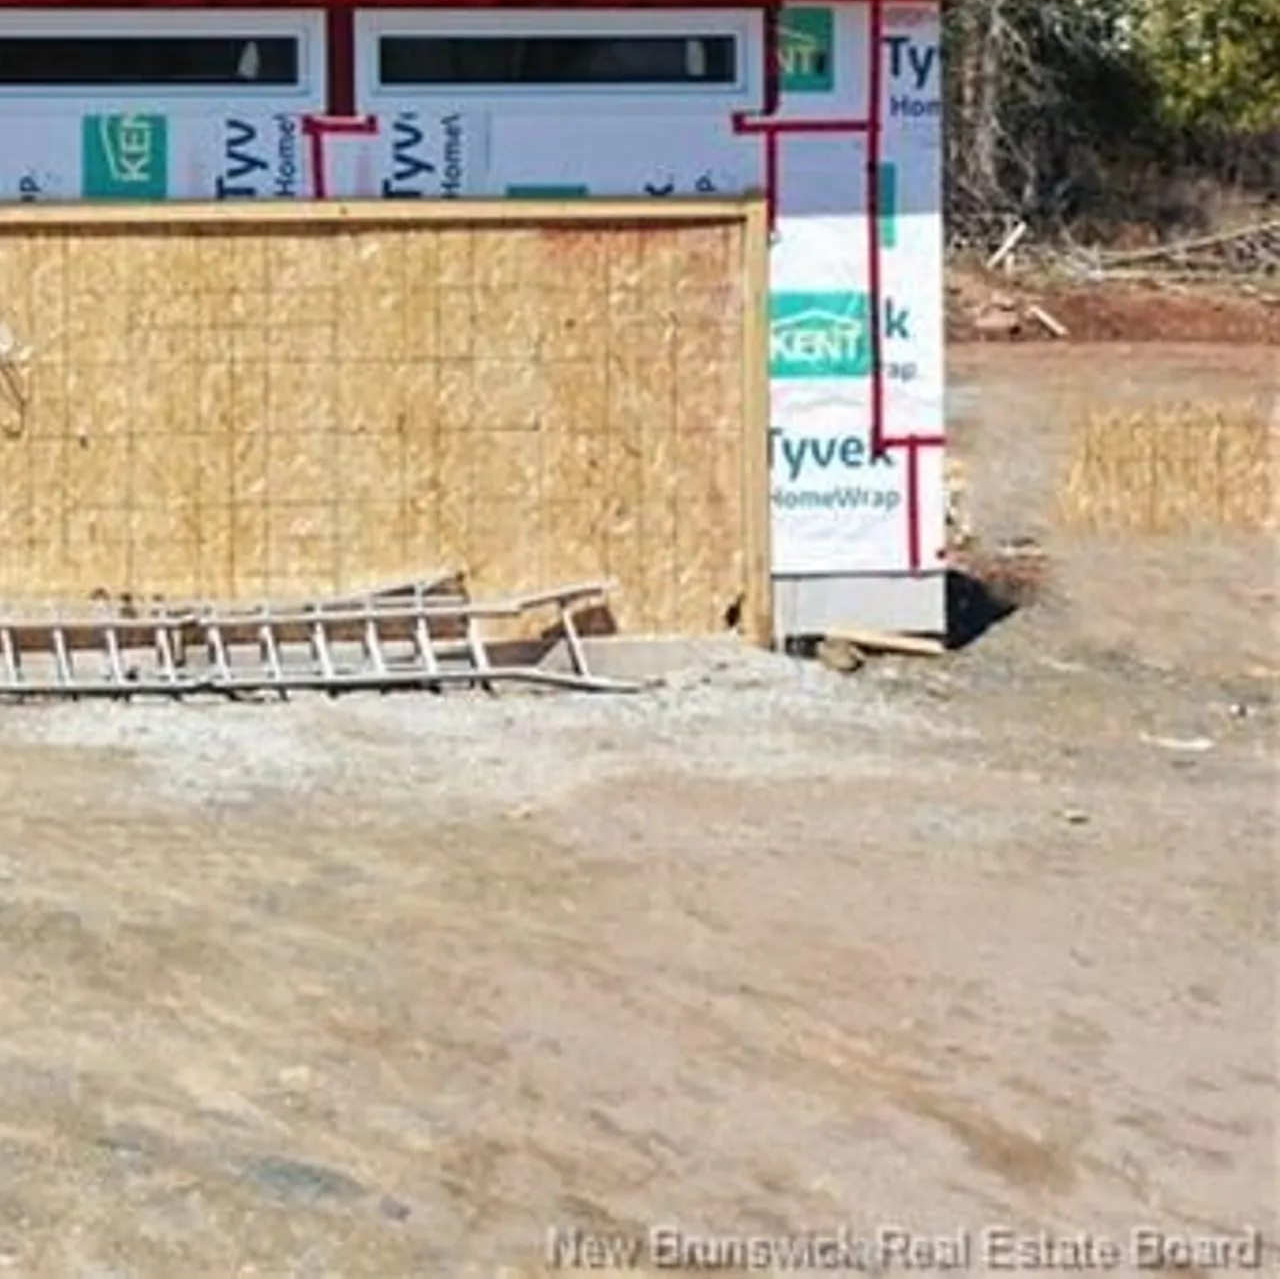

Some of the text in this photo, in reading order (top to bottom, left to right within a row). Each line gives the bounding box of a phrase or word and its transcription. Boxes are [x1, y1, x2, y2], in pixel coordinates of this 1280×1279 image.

[881, 36, 936, 90] Ty
[216, 118, 268, 199] Tyv
[382, 111, 436, 199] Tyv
[770, 329, 860, 361] KENT
